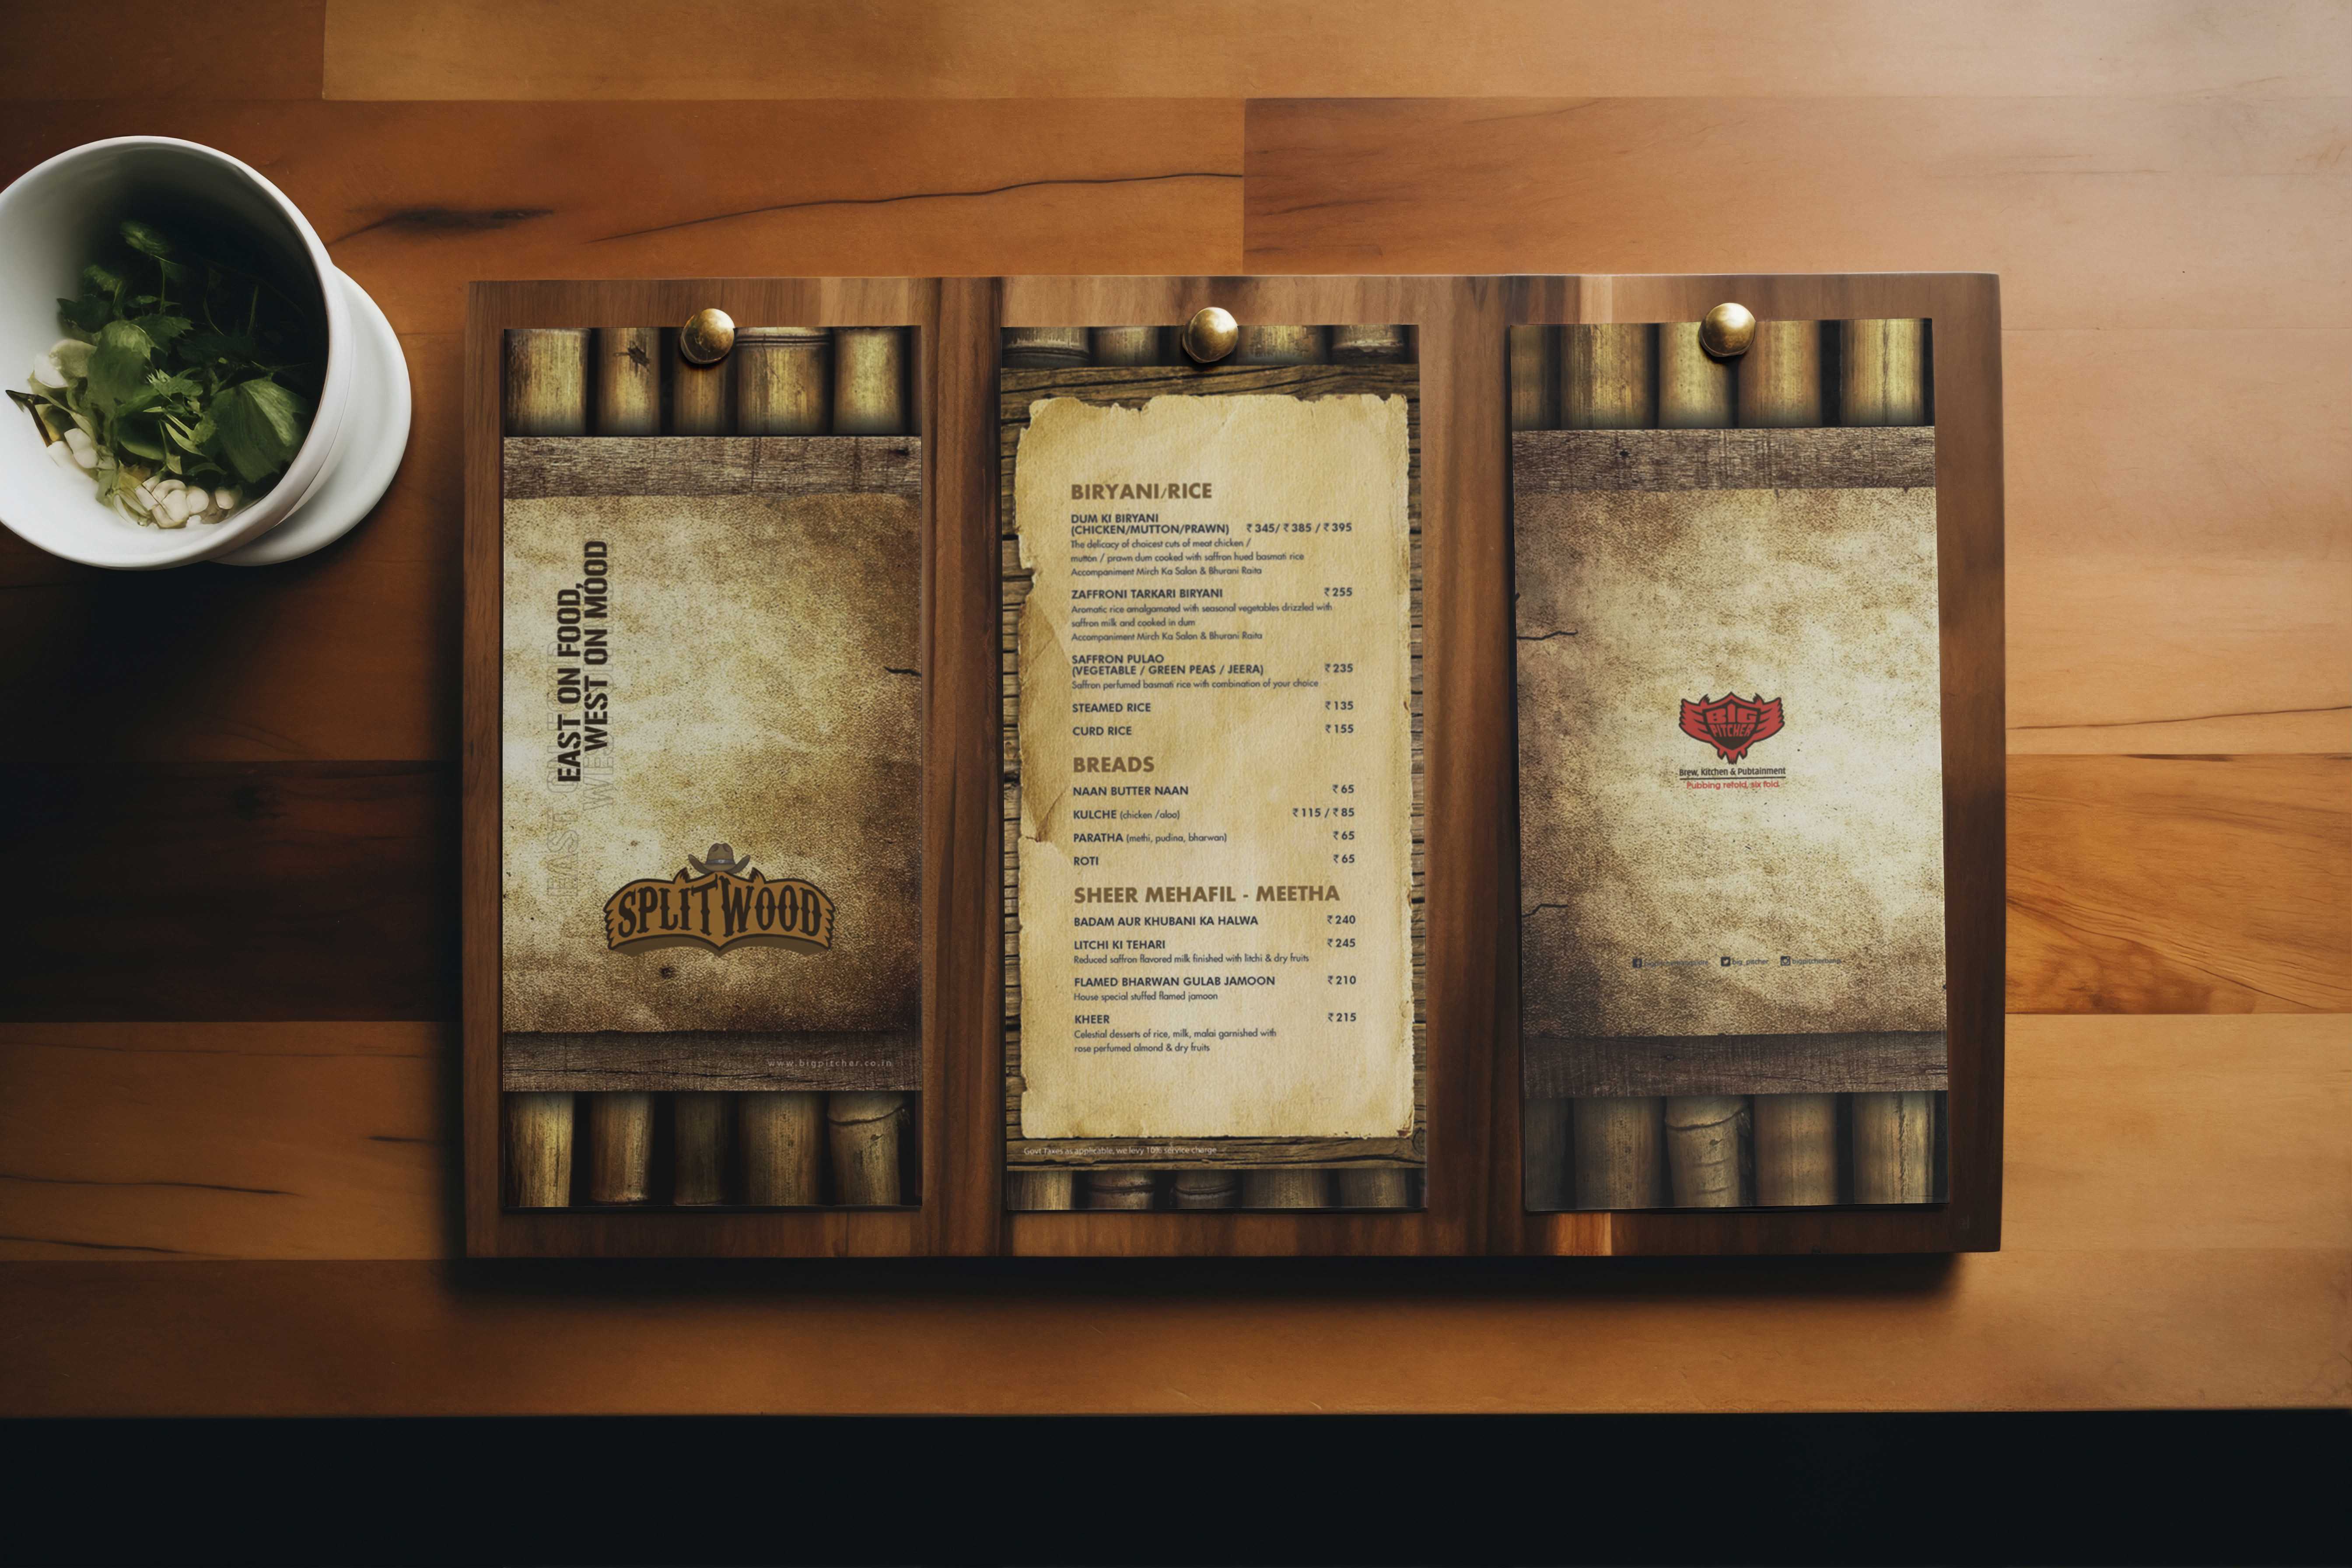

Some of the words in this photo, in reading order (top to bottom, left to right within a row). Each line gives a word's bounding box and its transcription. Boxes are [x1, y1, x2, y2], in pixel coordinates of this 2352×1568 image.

[1071, 514, 1098, 524] DUM
[1101, 514, 1112, 524] KI
[1115, 513, 1159, 524] BIRYANI
[1070, 539, 1086, 550] The
[1086, 538, 1120, 551] delicacy
[1121, 538, 1130, 549] of
[1131, 538, 1164, 549] choicest
[1164, 540, 1181, 548] cuts
[1181, 537, 1191, 548] of
[1213, 537, 1244, 548] chicken
[1070, 555, 1098, 563] mutton
[1106, 556, 1134, 564] prawn
[1134, 552, 1153, 563] dum
[1154, 551, 1184, 562] cooked
[1185, 551, 1202, 561] with
[1204, 551, 1232, 562] saffron
[1233, 551, 1254, 562] hued
[1255, 551, 1287, 561] basmati
[1070, 568, 1135, 578] Accompaniment
[1136, 566, 1159, 576] Mirch
[1161, 567, 1173, 576] Ka
[1208, 565, 1239, 575] Bhurani
[1241, 566, 1263, 575] Raita
[584, 541, 608, 619] MOOD
[1071, 589, 1127, 600] ZAFFRONI
[1130, 588, 1176, 599] TARKARI
[1179, 588, 1223, 598] BIRYANI
[1071, 605, 1108, 614] Aromatic
[1126, 603, 1181, 616] amalgamated
[1182, 603, 1200, 612] with
[1201, 602, 1236, 613] seasonal
[1238, 602, 1280, 615] vegetables
[1281, 602, 1314, 612] drizzled
[1316, 602, 1333, 611] with
[556, 583, 584, 657] FOOD,
[1071, 617, 1099, 628] saffron
[1100, 617, 1117, 627] milk
[1119, 617, 1136, 627] and
[1137, 617, 1166, 627] cooked
[1177, 616, 1196, 627] dum
[584, 629, 608, 665] ON
[1071, 654, 1124, 665] SAFFRON
[1127, 654, 1165, 664] PULAO
[1072, 665, 1137, 677] (VEGETABLE
[1148, 665, 1186, 675] GREEN
[1189, 664, 1216, 675] PEAS
[1227, 664, 1264, 676] JEERA)
[556, 668, 581, 705] ON
[1071, 679, 1101, 690] Saffron
[1102, 679, 1141, 691] perfumed
[1142, 679, 1174, 689] basmati
[1193, 679, 1210, 688] with
[1211, 678, 1261, 689] combination
[1262, 677, 1271, 688] of
[1272, 681, 1291, 690] your
[1292, 677, 1319, 688] choice
[584, 675, 608, 752] WEST
[1072, 703, 1124, 713] STEAMED
[1127, 702, 1151, 712] RICE
[1706, 703, 1758, 724] BIG
[1072, 726, 1104, 736] CURD
[1107, 725, 1132, 736] RICE
[1708, 723, 1756, 738] PITCHER
[556, 713, 581, 782] EAST
[1073, 756, 1155, 774] BREADS
[1678, 768, 1699, 777] Brew,
[1701, 767, 1729, 776] Kitchen
[1730, 767, 1736, 776] &
[1737, 766, 1786, 776] Pubtainment
[1073, 786, 1107, 796] NAAN
[1110, 786, 1151, 796] BUTTER
[1154, 786, 1189, 795] NAAN
[1686, 781, 1722, 791] Pubbing
[1723, 780, 1749, 789] retold,
[1750, 780, 1762, 788] six
[1073, 809, 1117, 820] KULCHE
[1119, 809, 1153, 821] (chicken
[1073, 832, 1124, 843] PARATHA
[1126, 833, 1153, 844] (methi,
[1155, 832, 1186, 844] pudina,
[1188, 832, 1227, 843] bharwan)
[1073, 856, 1099, 866] ROTI
[1074, 886, 1139, 904] SHEER
[1144, 886, 1236, 903] MEHAFIL
[1256, 885, 1340, 902] MEETHA
[618, 873, 823, 938] SPLITWOOD
[1074, 917, 1115, 927] BADAM
[1117, 916, 1141, 927] AUR
[1144, 916, 1196, 927] KHUBANI
[1200, 916, 1215, 926] KA
[1218, 915, 1259, 926] HALWA
[1074, 940, 1109, 950] LITCHI
[1112, 940, 1123, 950] KI
[1126, 939, 1166, 950] TEHARI
[1073, 954, 1108, 964] Reduced
[1110, 953, 1138, 964] saffron
[1139, 953, 1172, 964] flavored
[1173, 953, 1191, 963] milk
[1192, 953, 1224, 963] finished
[1225, 953, 1242, 962] with
[1244, 953, 1263, 963] litchi
[1273, 952, 1288, 965] dry
[1290, 952, 1310, 962] fruits
[1074, 977, 1119, 987] FLAMED
[1122, 976, 1180, 987] BHARWAN
[1183, 976, 1222, 987] GULAB
[1223, 976, 1275, 986] JAMOON
[1073, 992, 1099, 1001] House
[1100, 990, 1129, 1004] special
[1130, 990, 1157, 1001] stuffed
[1158, 990, 1186, 1001] flamed
[1188, 991, 1218, 1002] jamoon
[1074, 1014, 1110, 1025] KHEER
[1074, 1028, 1108, 1040] Celestial
[1109, 1028, 1141, 1039] desserts
[1142, 1028, 1152, 1039] of
[1153, 1029, 1171, 1040] rice,
[1172, 1028, 1192, 1039] milk,
[1194, 1028, 1217, 1038] malai
[1218, 1027, 1258, 1040] garnished
[1260, 1027, 1277, 1037] with
[1093, 1042, 1131, 1055] perfumed
[1133, 1042, 1164, 1053] almond
[1174, 1042, 1189, 1054] dry
[1190, 1041, 1211, 1052] fruits
[767, 1058, 892, 1068] www.bigpitcher.co.in
[1023, 1147, 1042, 1155] Govt
[1043, 1147, 1063, 1155] Taxes
[1074, 1146, 1115, 1156] applicable,
[1129, 1146, 1144, 1156] levy
[1146, 1146, 1163, 1155] 10%
[1163, 1146, 1190, 1155] service
[1191, 1145, 1217, 1155] charge
